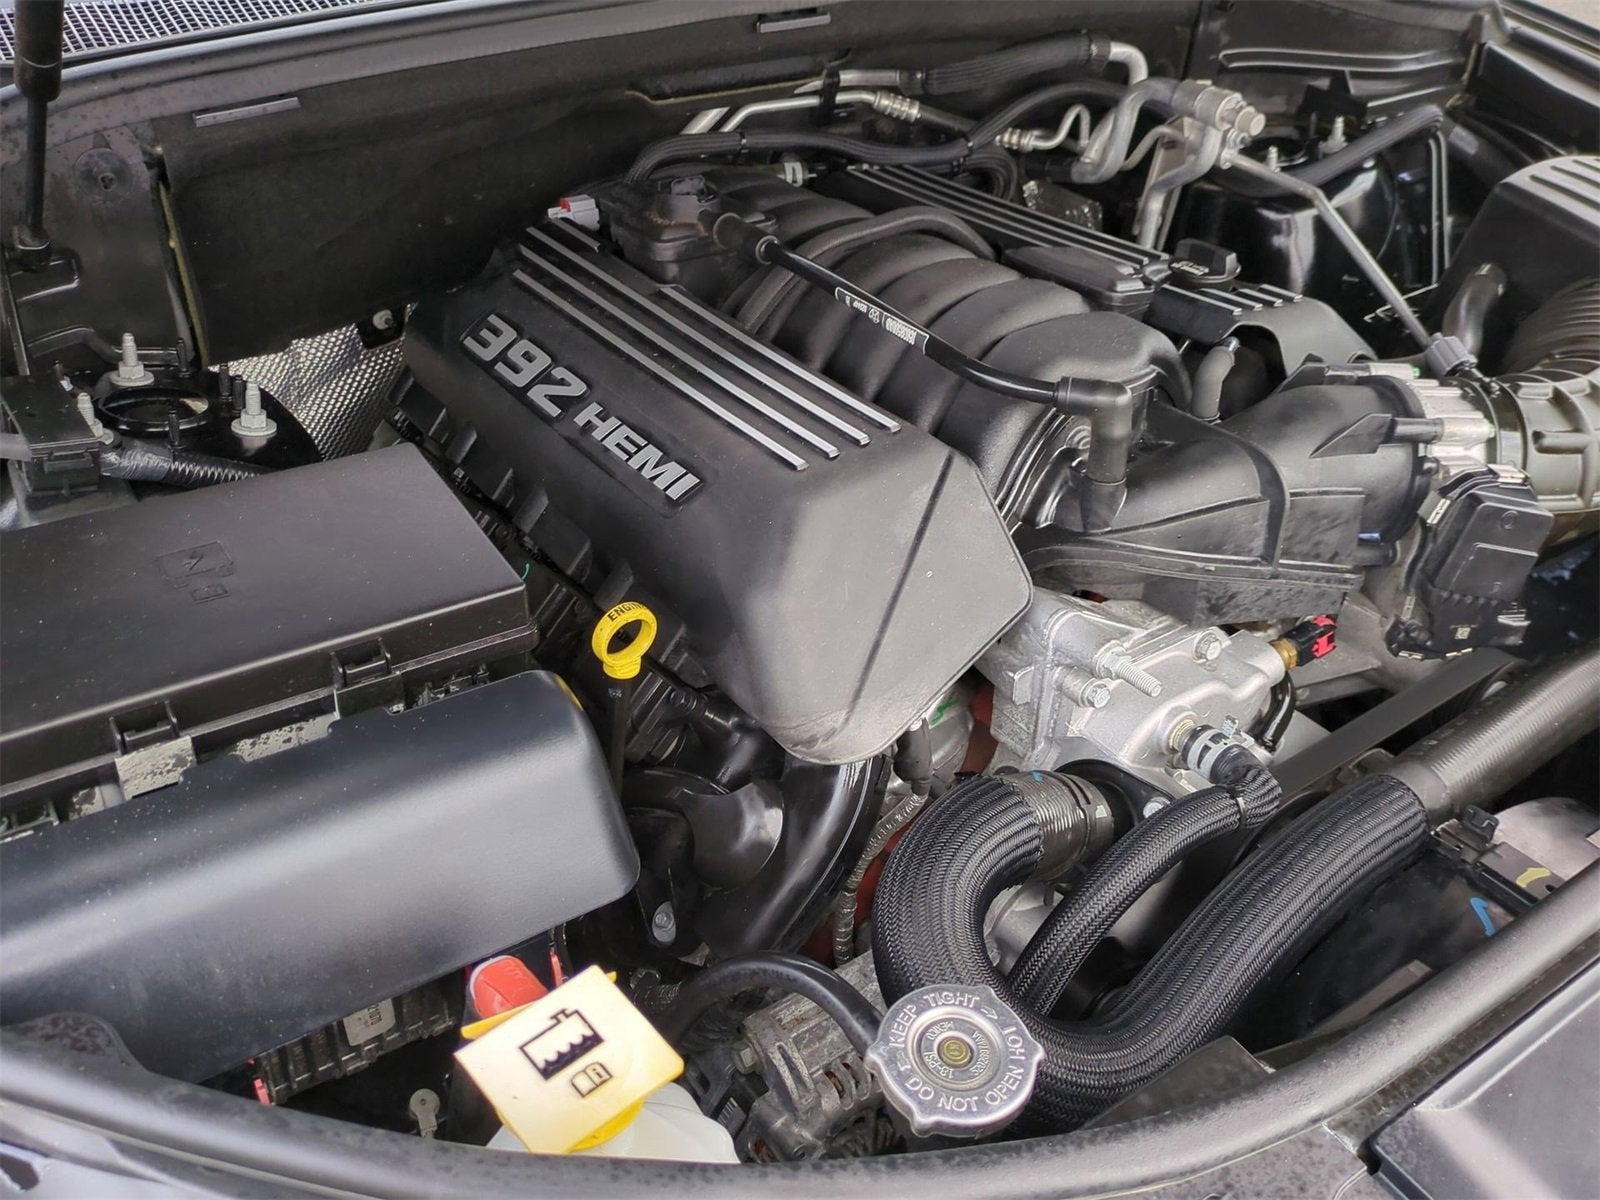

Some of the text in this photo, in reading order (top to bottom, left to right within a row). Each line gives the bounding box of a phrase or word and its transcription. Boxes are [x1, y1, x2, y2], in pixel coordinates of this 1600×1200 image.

[463, 313, 700, 500] 392 HEMI
[607, 602, 645, 622] ENGIN
[888, 991, 981, 1047] KEEP TIGHT
[905, 1026, 1027, 1112] DO NOT OPEN HOT
